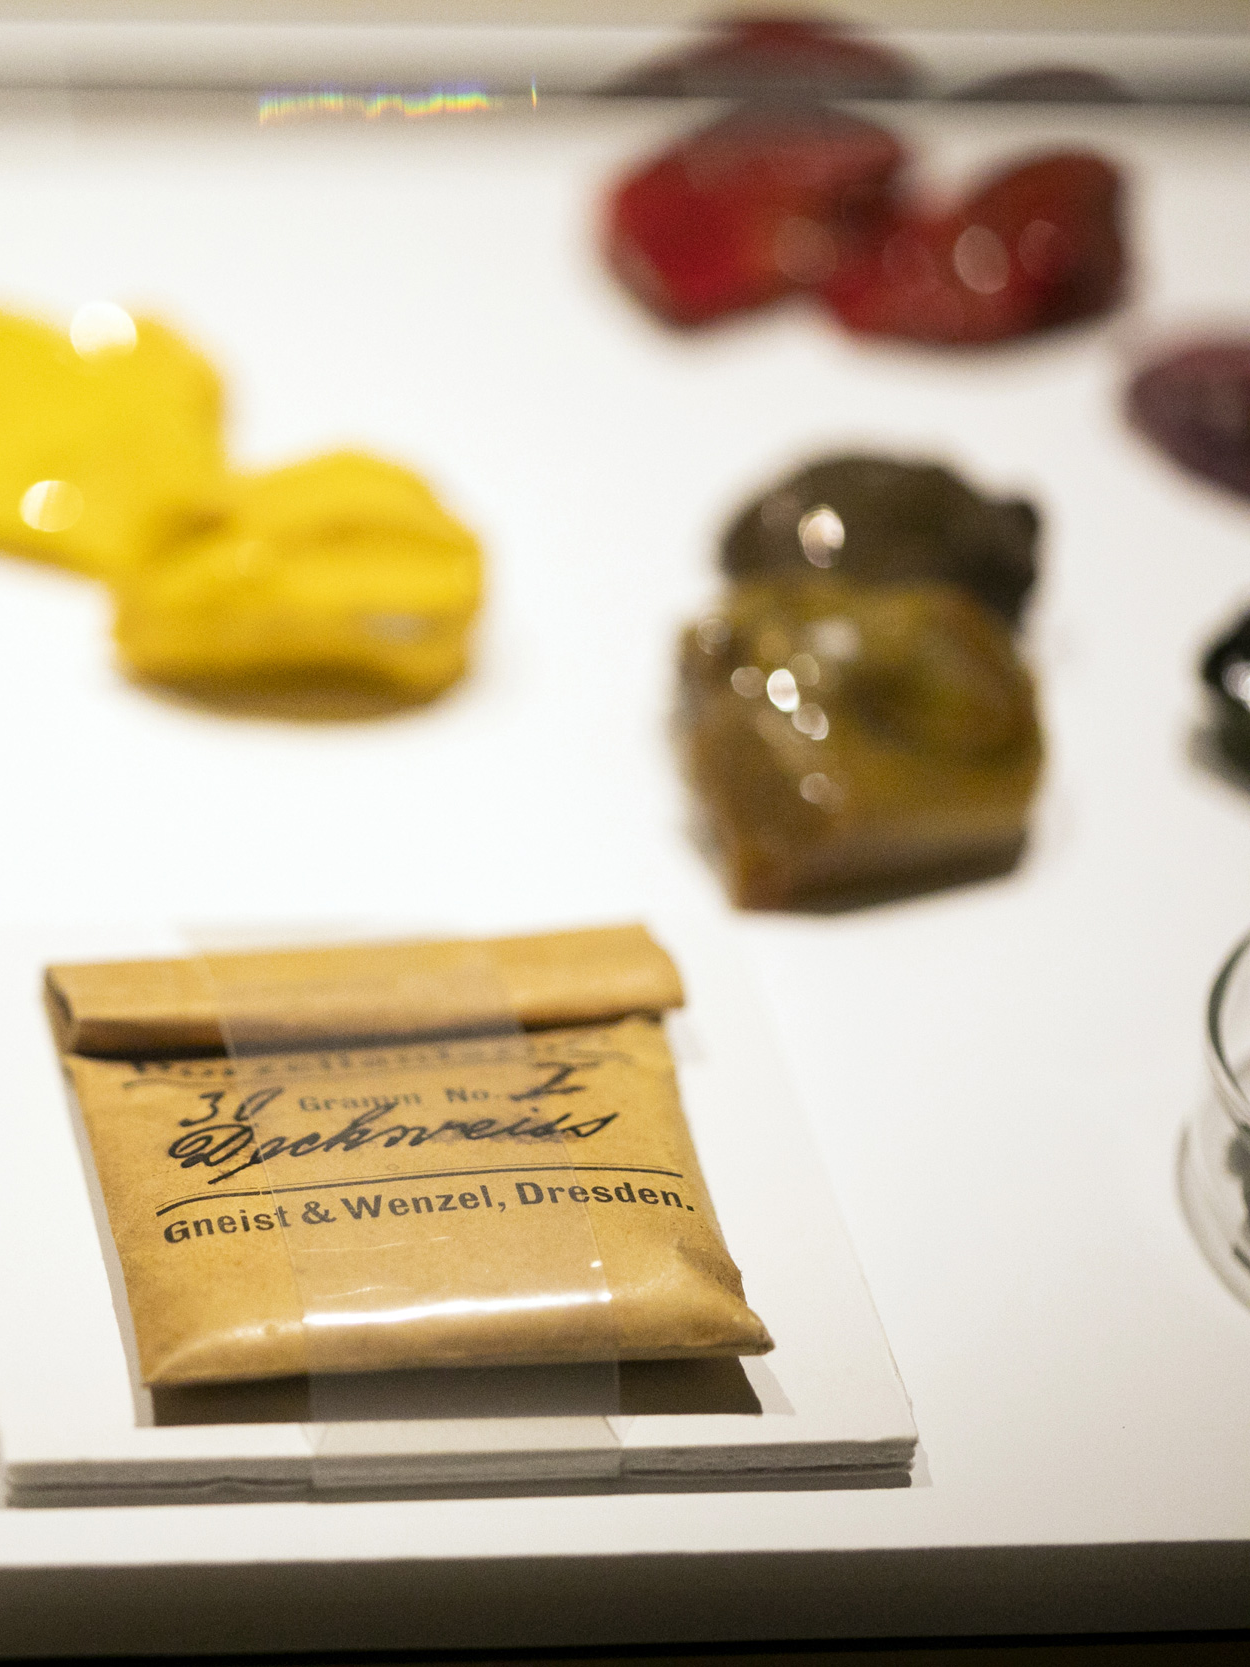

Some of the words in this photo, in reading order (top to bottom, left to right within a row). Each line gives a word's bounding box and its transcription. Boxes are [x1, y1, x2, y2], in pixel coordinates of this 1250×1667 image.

[163, 1204, 292, 1244] Gneist
[301, 1200, 337, 1225] &
[340, 1184, 507, 1220] Wenzel,
[514, 1181, 695, 1212] Dresden.
